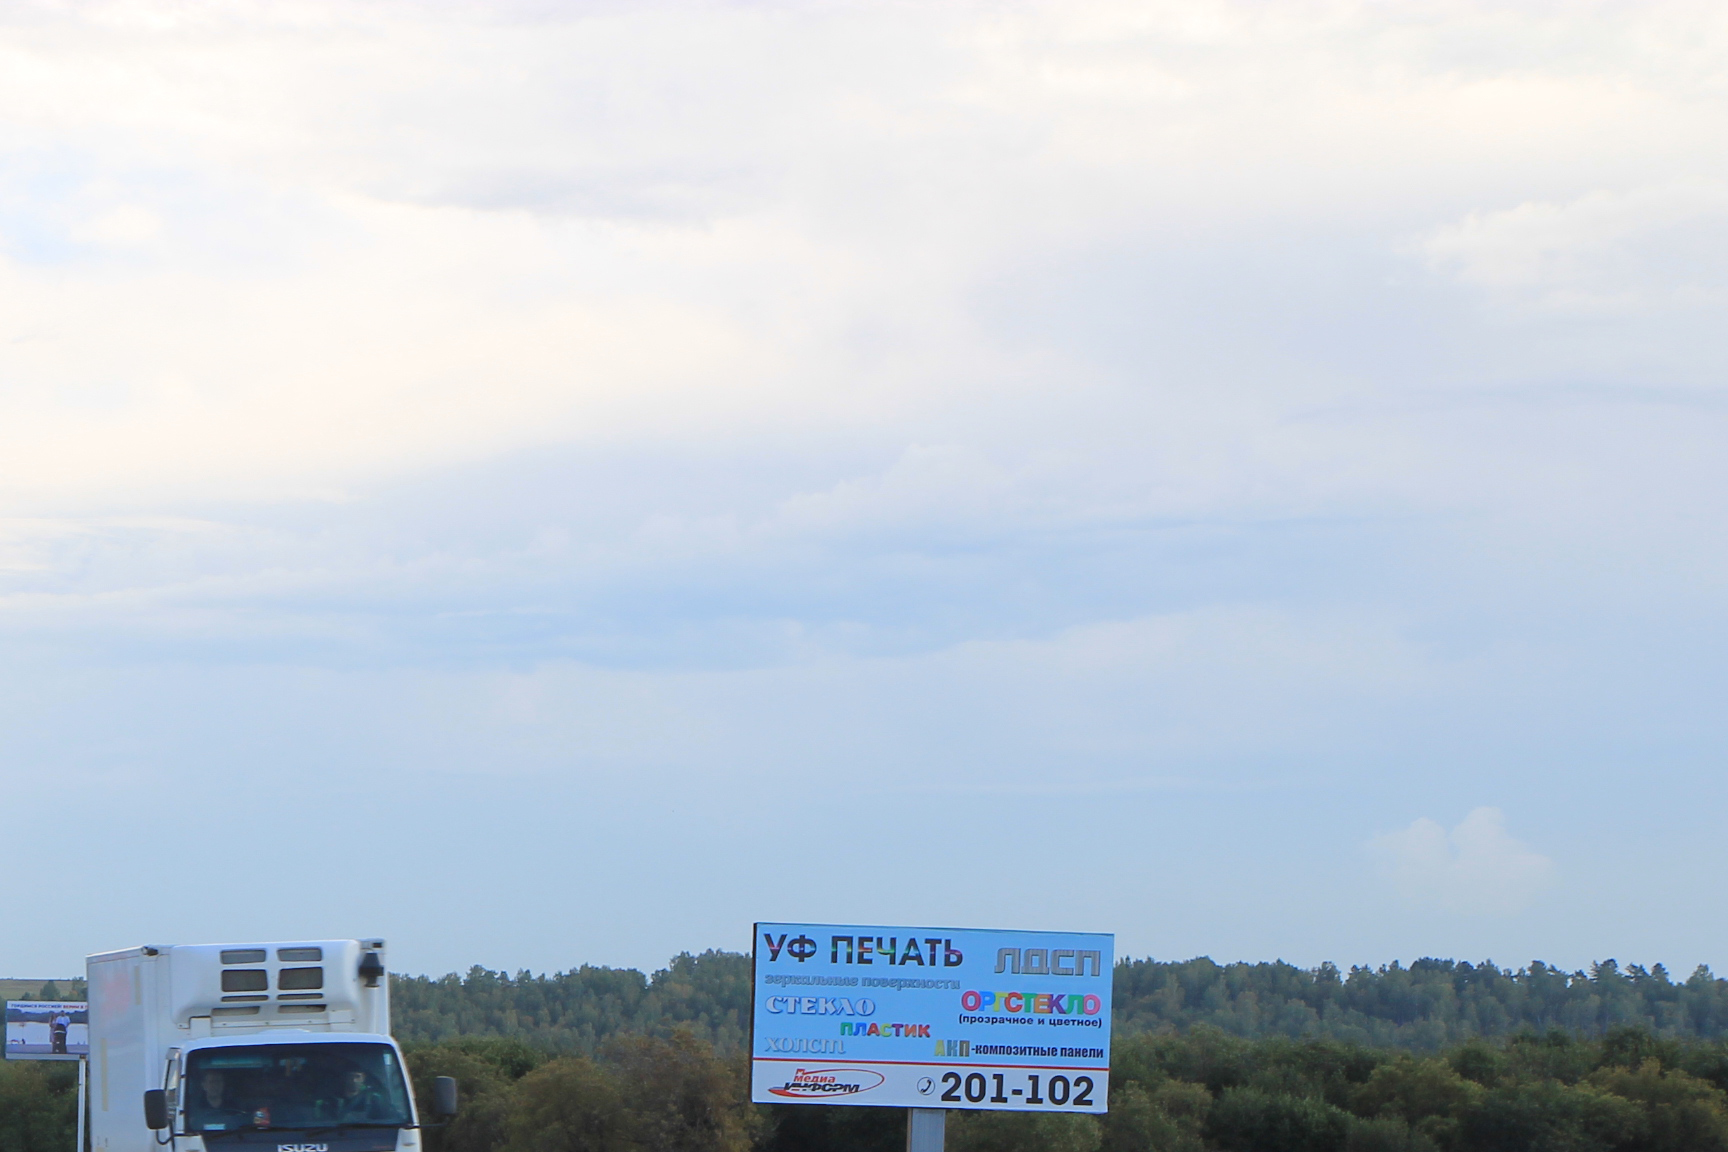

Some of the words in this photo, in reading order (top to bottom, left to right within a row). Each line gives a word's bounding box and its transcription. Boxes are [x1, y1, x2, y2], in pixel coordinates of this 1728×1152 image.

[763, 933, 817, 962] УФ
[830, 935, 963, 967] ПЕЧАТЬ
[994, 947, 1101, 977] ЛДСП
[765, 974, 859, 988] зеркальные
[861, 976, 960, 991] поверхности
[765, 995, 876, 1016] СТЕКЛО
[961, 990, 1101, 1015] ОРГСТЕКЛО
[840, 1022, 931, 1038] ПЛАСТИК
[959, 1013, 1034, 1025] (прозрачное
[1049, 1017, 1102, 1028] цветное)
[1060, 1047, 1104, 1059] панели
[941, 1071, 1094, 1106] 201-102
[277, 1143, 329, 1152] ISUZU
